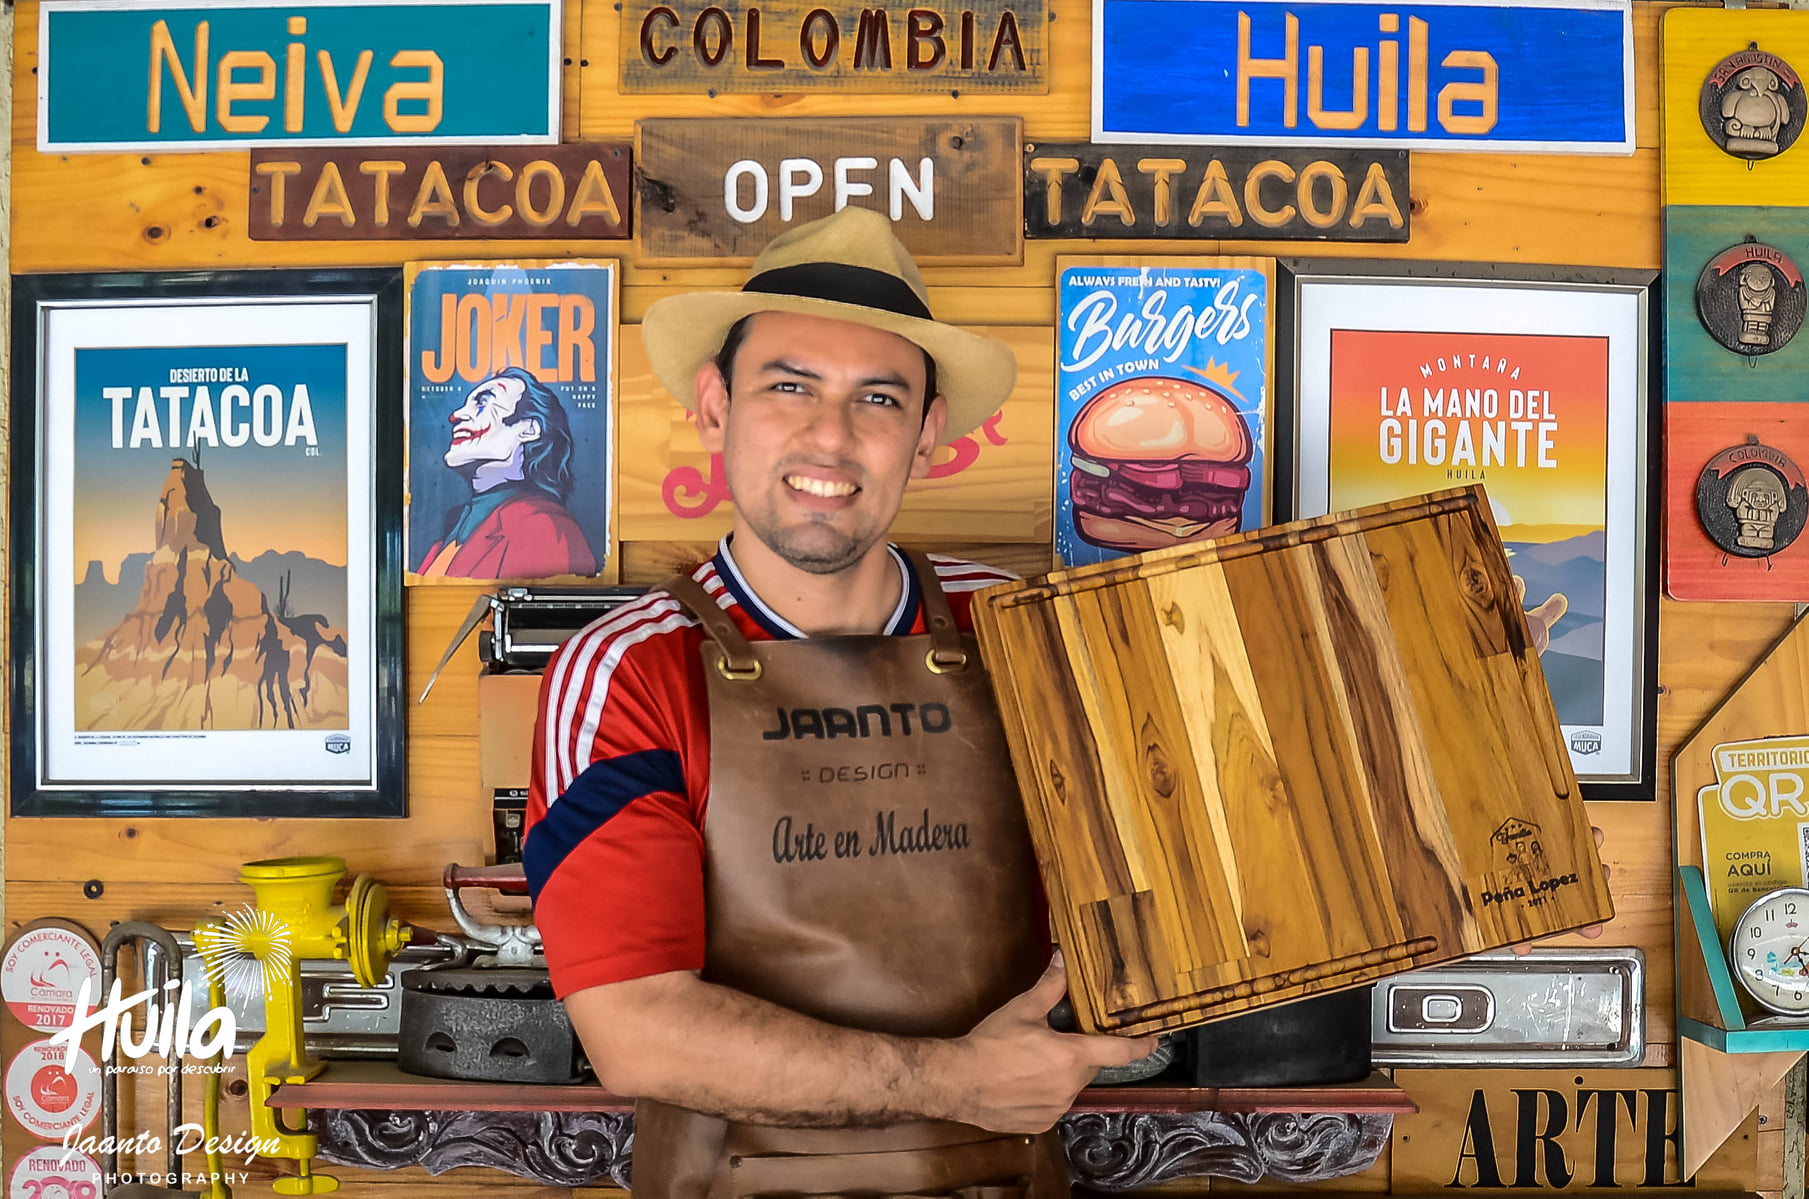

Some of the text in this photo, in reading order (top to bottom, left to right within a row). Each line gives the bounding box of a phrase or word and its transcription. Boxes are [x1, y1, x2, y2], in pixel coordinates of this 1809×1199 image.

[640, 6, 1027, 72] COLOMBIA
[147, 16, 444, 133] Neiva
[1236, 10, 1499, 134] Huila
[256, 159, 621, 229] TATACOA
[1030, 158, 1404, 228] TATACOA
[1745, 247, 1783, 264] HUILA
[1069, 276, 1115, 287] ALWAYS
[1155, 277, 1181, 287] AND
[1184, 278, 1220, 288] TASTY!
[1061, 280, 1258, 372] Burgers
[422, 293, 596, 383] JOKER
[169, 367, 249, 383] DESIERTO DE LA
[1068, 358, 1160, 401] BEST IN TOWN
[1380, 387, 1556, 419] LA MANO DEL
[102, 384, 318, 449] TATACOA
[1379, 418, 1558, 468] GIGANTE
[1729, 447, 1788, 468] COLOMBIA
[1447, 469, 1485, 479] HUILA
[762, 702, 951, 740] JAANTO
[1573, 741, 1598, 752] MUCA
[819, 763, 909, 783] DESIGN
[1722, 772, 1806, 817] QR
[773, 808, 971, 864] Arte en Madera
[1725, 851, 1771, 860] COMPRA
[1727, 859, 1771, 877] AQUÍ
[1481, 887, 1525, 906] Peña
[1765, 909, 1775, 921] 11
[1784, 903, 1797, 915] 12
[1750, 927, 1762, 938] 10
[6, 932, 97, 977] SOY COMERCIANTE LEGAL
[1747, 948, 1756, 960] 9
[1772, 985, 1780, 996] 7
[1794, 989, 1803, 1001] 6
[27, 1005, 74, 1014] RENOVADO
[36, 1014, 65, 1025] 2017
[41, 1052, 65, 1060] 2018
[79, 1092, 95, 1116] LEGAL
[1444, 1088, 1696, 1188] ARTE
